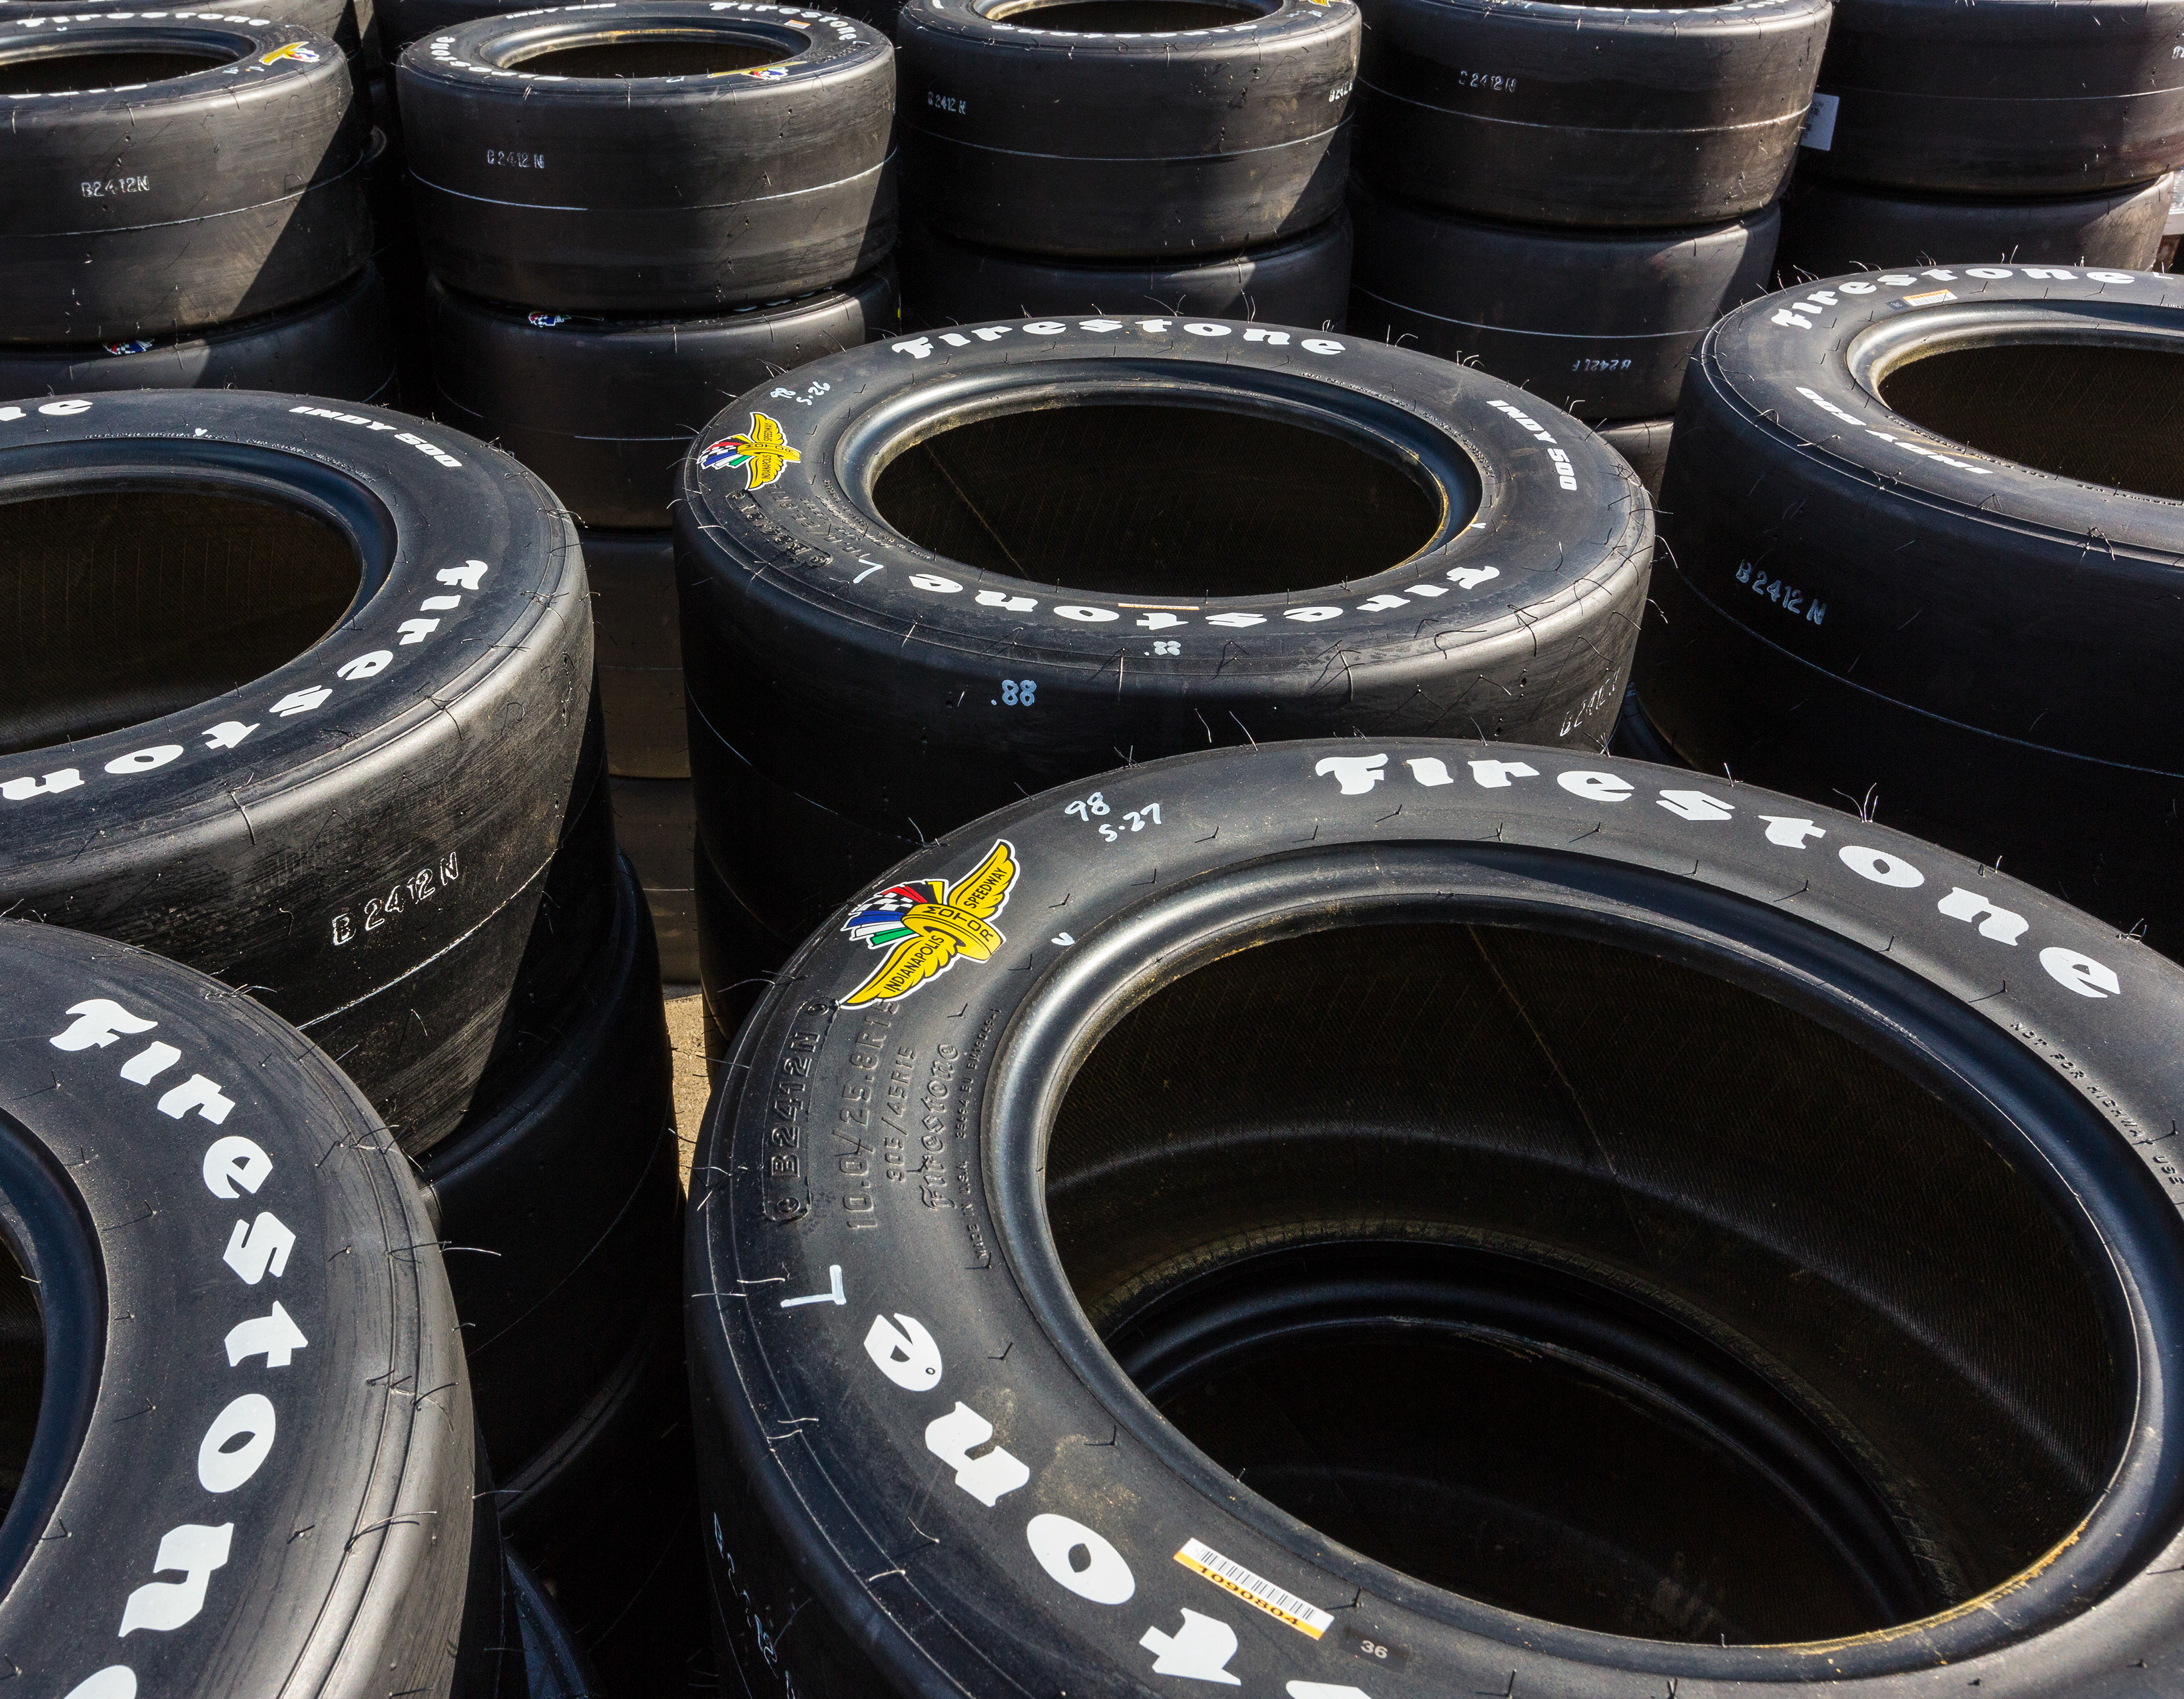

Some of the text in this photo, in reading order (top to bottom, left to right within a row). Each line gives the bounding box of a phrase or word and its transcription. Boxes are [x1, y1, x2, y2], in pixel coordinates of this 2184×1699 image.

[709, 1, 857, 41] Firestone
[81, 175, 150, 198] B2412N
[1771, 268, 2135, 330] Firestone
[892, 319, 1346, 358] Firestone
[288, 406, 462, 468] INDY 500
[1796, 387, 1867, 425] 500
[1486, 400, 1577, 491] INDY 500
[1866, 429, 1994, 474] INDY
[909, 565, 1500, 630] Firestone
[1735, 560, 1827, 625] B2412N
[0, 560, 488, 800] Fireston
[1064, 792, 1111, 821] 98
[332, 851, 458, 946] B2412N
[963, 867, 1007, 909] SPEEDWAY
[1316, 754, 2121, 998] Firestone
[921, 906, 994, 942] MOTOR
[883, 935, 945, 993] INDIANAPOLIS
[770, 1028, 821, 1178] B2412N
[2009, 1022, 2184, 1185] NOT FOR HIGHWAY USE
[1198, 1564, 1300, 1628] 1090804
[1360, 1640, 1388, 1660] 36
